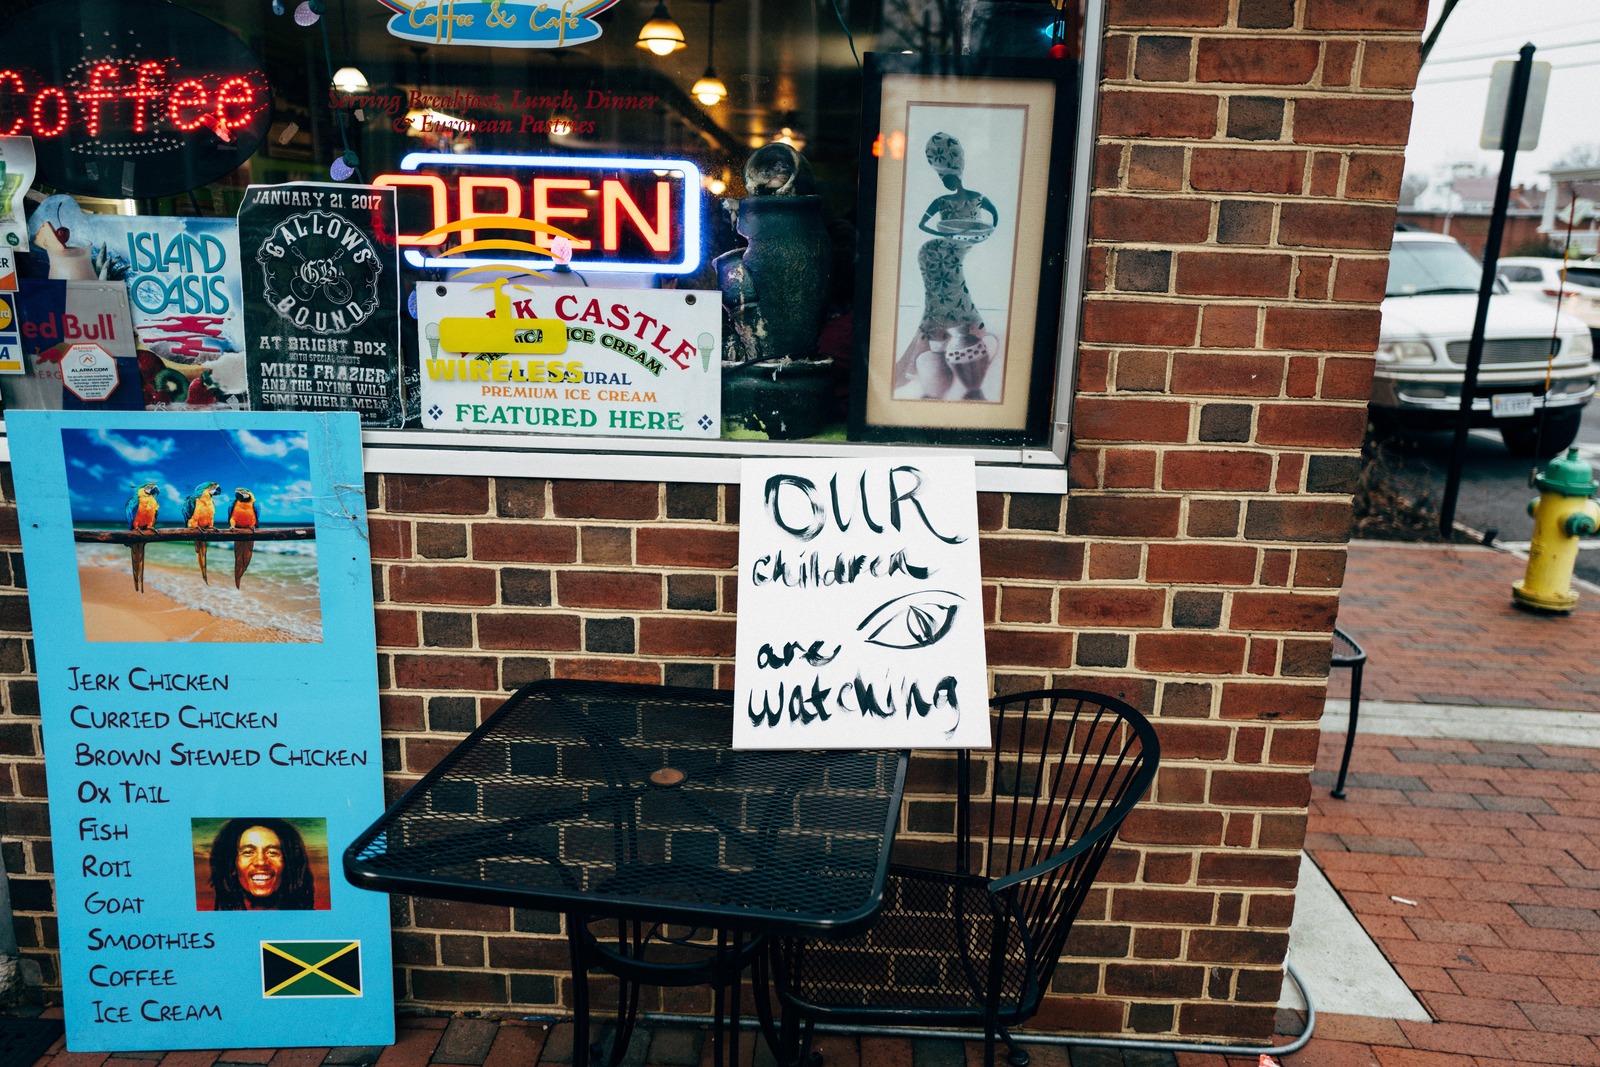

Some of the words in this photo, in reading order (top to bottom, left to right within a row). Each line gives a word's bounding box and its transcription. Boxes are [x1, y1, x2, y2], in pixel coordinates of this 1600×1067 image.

[410, 0, 475, 44] Coffee
[486, 1, 517, 28] &
[530, 0, 579, 46] Café
[328, 90, 400, 113] Serving
[407, 89, 504, 114] Breakfast,
[511, 90, 578, 112] Lunch,
[584, 89, 659, 110] Dinner
[420, 115, 512, 140] European
[520, 115, 595, 134] Pastries
[252, 191, 325, 207] JANUARY
[351, 194, 382, 211] 2017
[372, 173, 671, 252] OPEN
[127, 232, 227, 273] ISLAND
[266, 214, 371, 264] GALLOWS
[131, 275, 230, 315] OASIS
[276, 294, 365, 332] BOUND
[259, 336, 281, 350] AT
[288, 337, 348, 354] BRIGHT
[354, 341, 387, 356] BOX
[555, 294, 697, 371] CASTLE
[260, 362, 308, 378] MIKE
[313, 365, 387, 383] FRAZIER
[425, 359, 584, 383] WIRELESS
[261, 393, 348, 408] SOMEWHERE
[290, 379, 312, 392] THE
[316, 381, 352, 393] DYING
[357, 383, 387, 397] WILD
[481, 385, 559, 400] PREMIUM
[564, 388, 591, 402] ICE
[597, 389, 657, 403] CREAM
[455, 403, 597, 428] FEATURED
[609, 410, 685, 431] HERE
[764, 465, 969, 545] OUR
[757, 640, 842, 669] are
